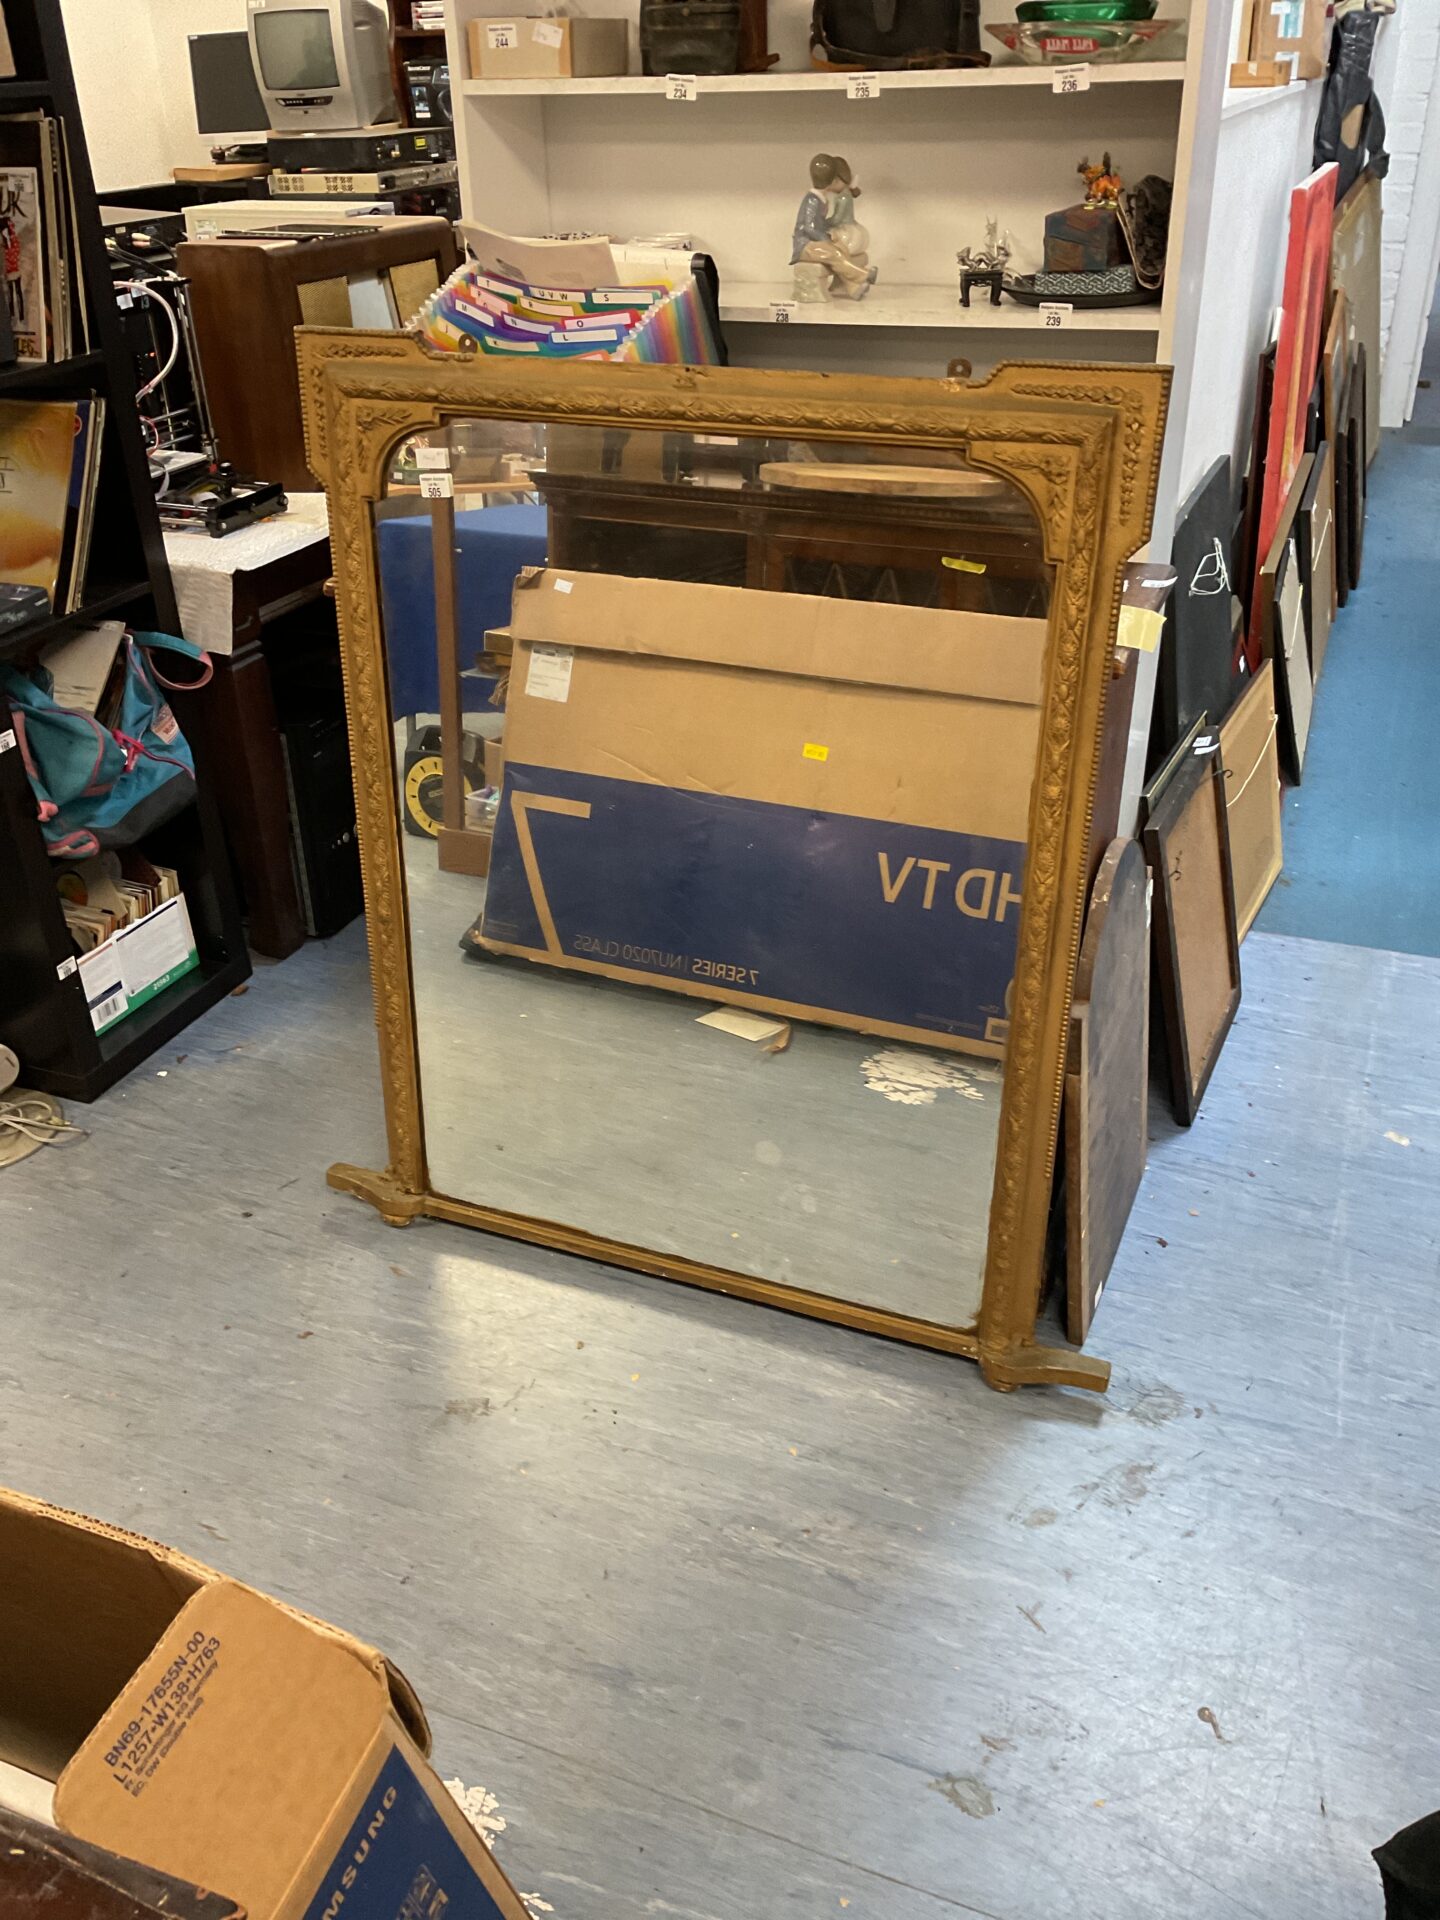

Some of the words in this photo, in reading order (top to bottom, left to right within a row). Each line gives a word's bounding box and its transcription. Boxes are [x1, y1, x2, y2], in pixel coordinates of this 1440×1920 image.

[495, 37, 509, 48] 244
[855, 86, 870, 98] 235
[1061, 80, 1078, 92] 236
[673, 87, 687, 99] 234
[1046, 315, 1062, 327] 239
[187, 1658, 219, 1702] Germany
[103, 1630, 206, 1767] BN69-17655N-00
[145, 1757, 161, 1778] DW
